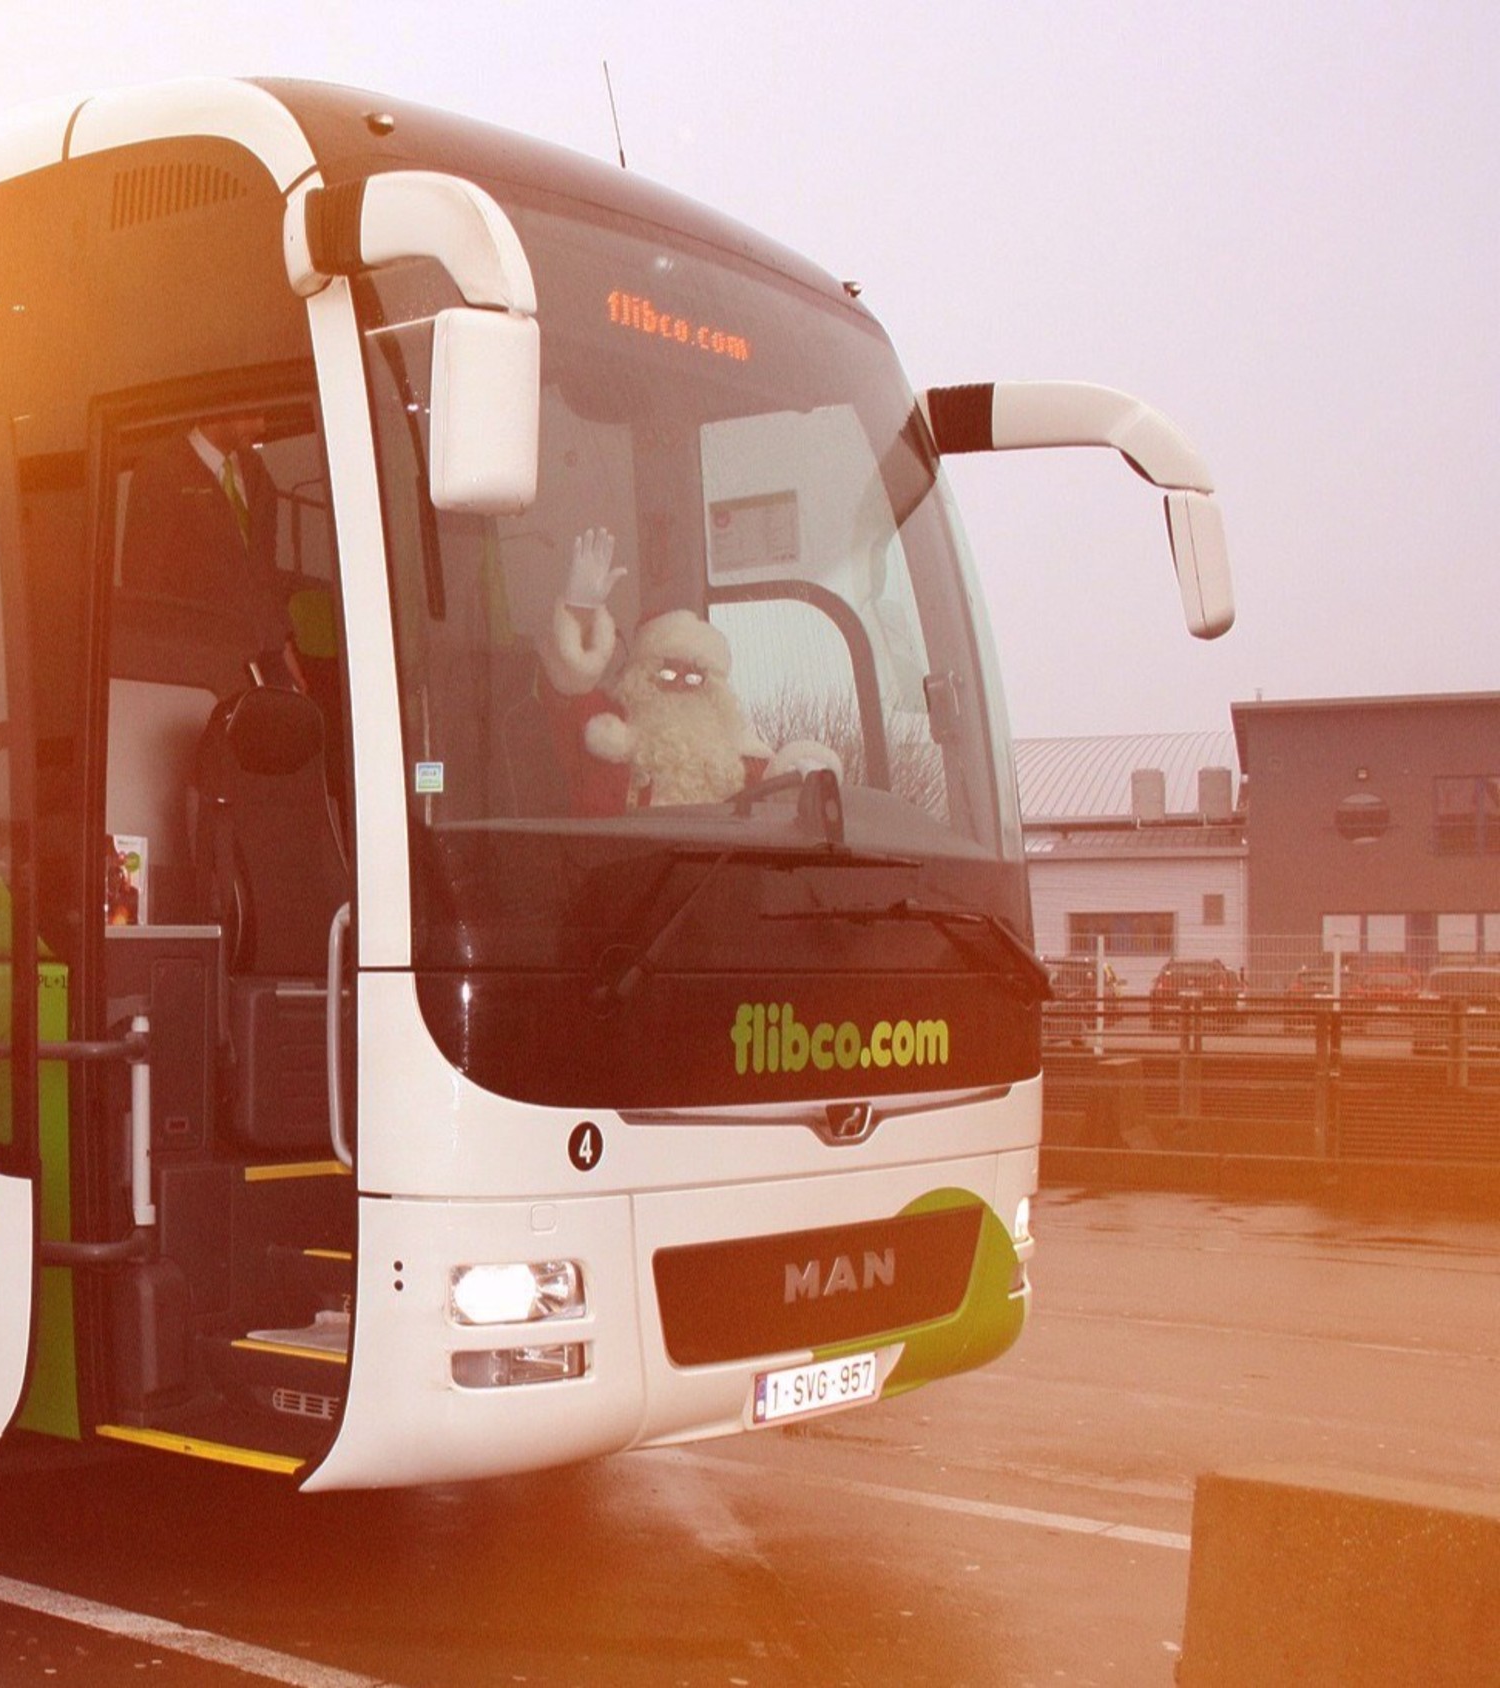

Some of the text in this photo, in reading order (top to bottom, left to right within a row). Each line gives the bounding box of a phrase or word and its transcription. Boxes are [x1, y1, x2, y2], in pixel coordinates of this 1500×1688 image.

[607, 290, 749, 361] flibco.com
[731, 1002, 949, 1075] flibco.com
[578, 1129, 593, 1164] 4
[784, 1248, 896, 1303] MAN
